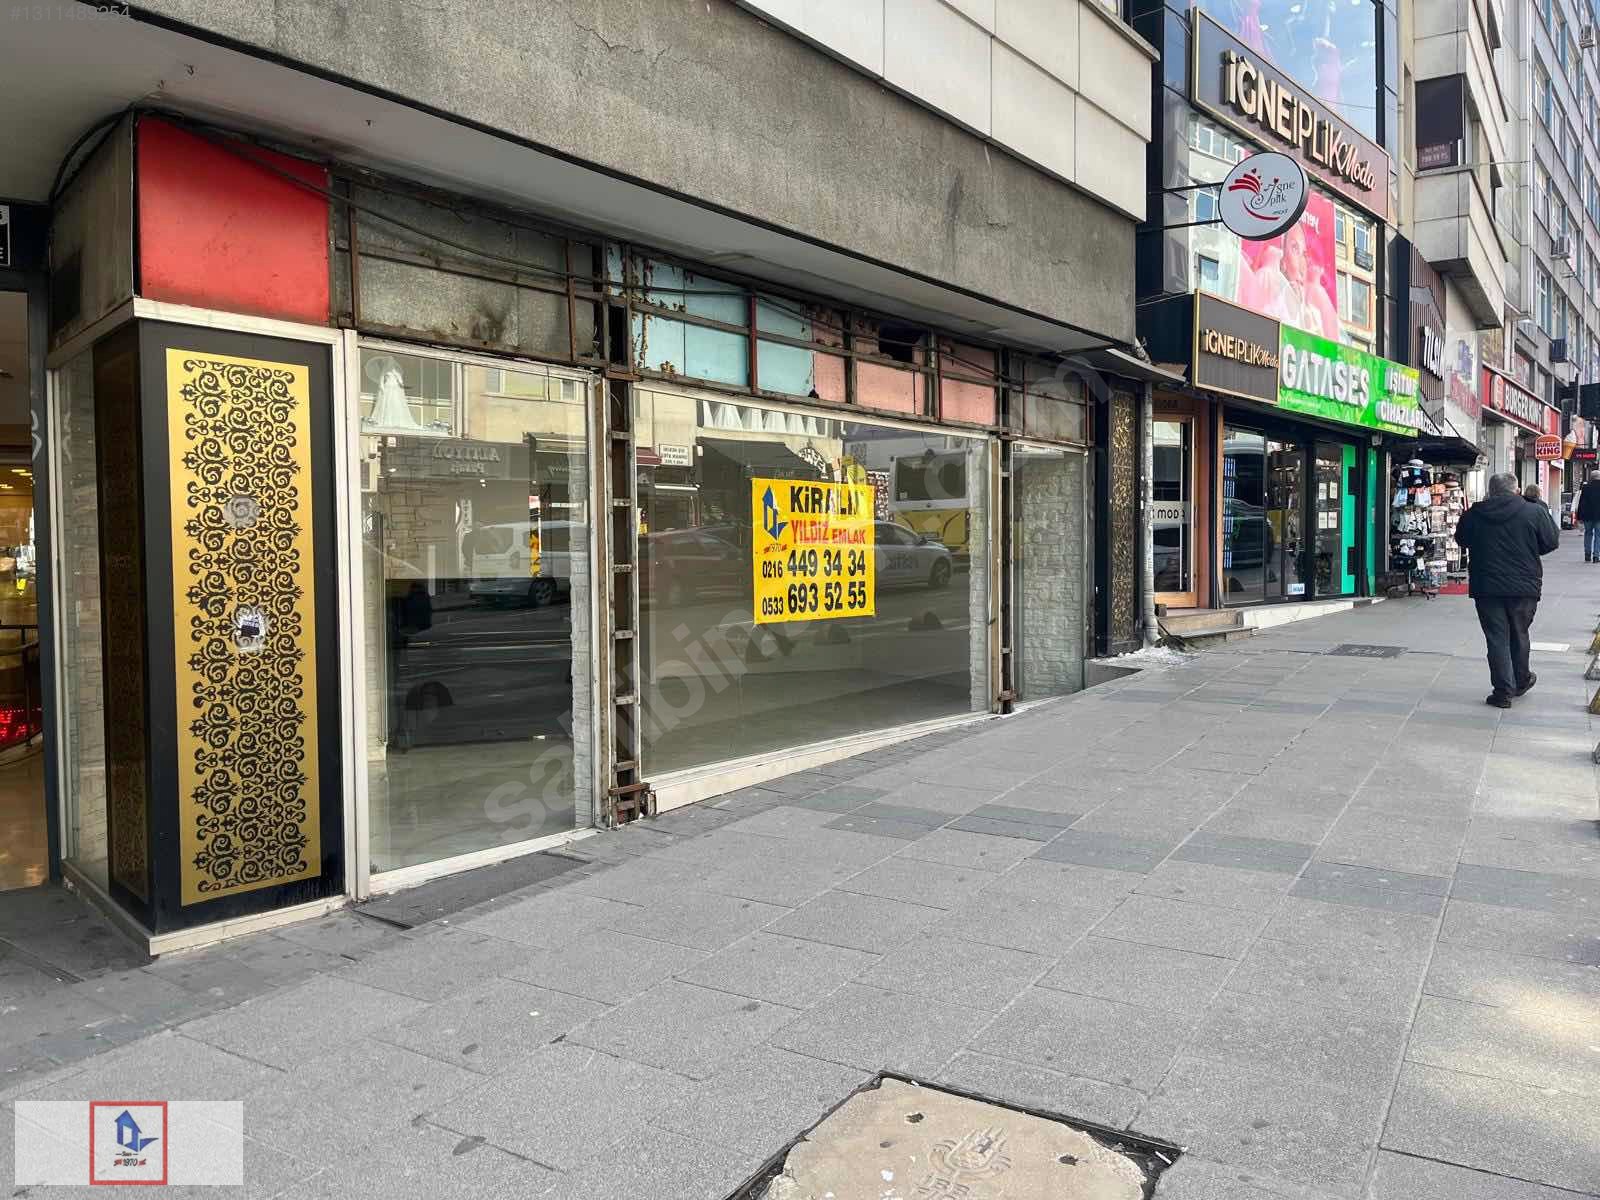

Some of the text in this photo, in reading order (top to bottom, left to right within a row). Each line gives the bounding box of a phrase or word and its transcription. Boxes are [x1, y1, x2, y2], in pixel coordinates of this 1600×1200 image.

[1282, 344, 1370, 408] GATASES
[1504, 383, 1529, 422] BURGER
[1536, 447, 1561, 455] KING
[832, 529, 866, 544] EMLAK
[762, 561, 783, 578] 0216
[788, 549, 818, 577] 449
[823, 549, 842, 577] 34
[847, 550, 866, 576] 34
[762, 581, 866, 615] 0533 693 52 55
